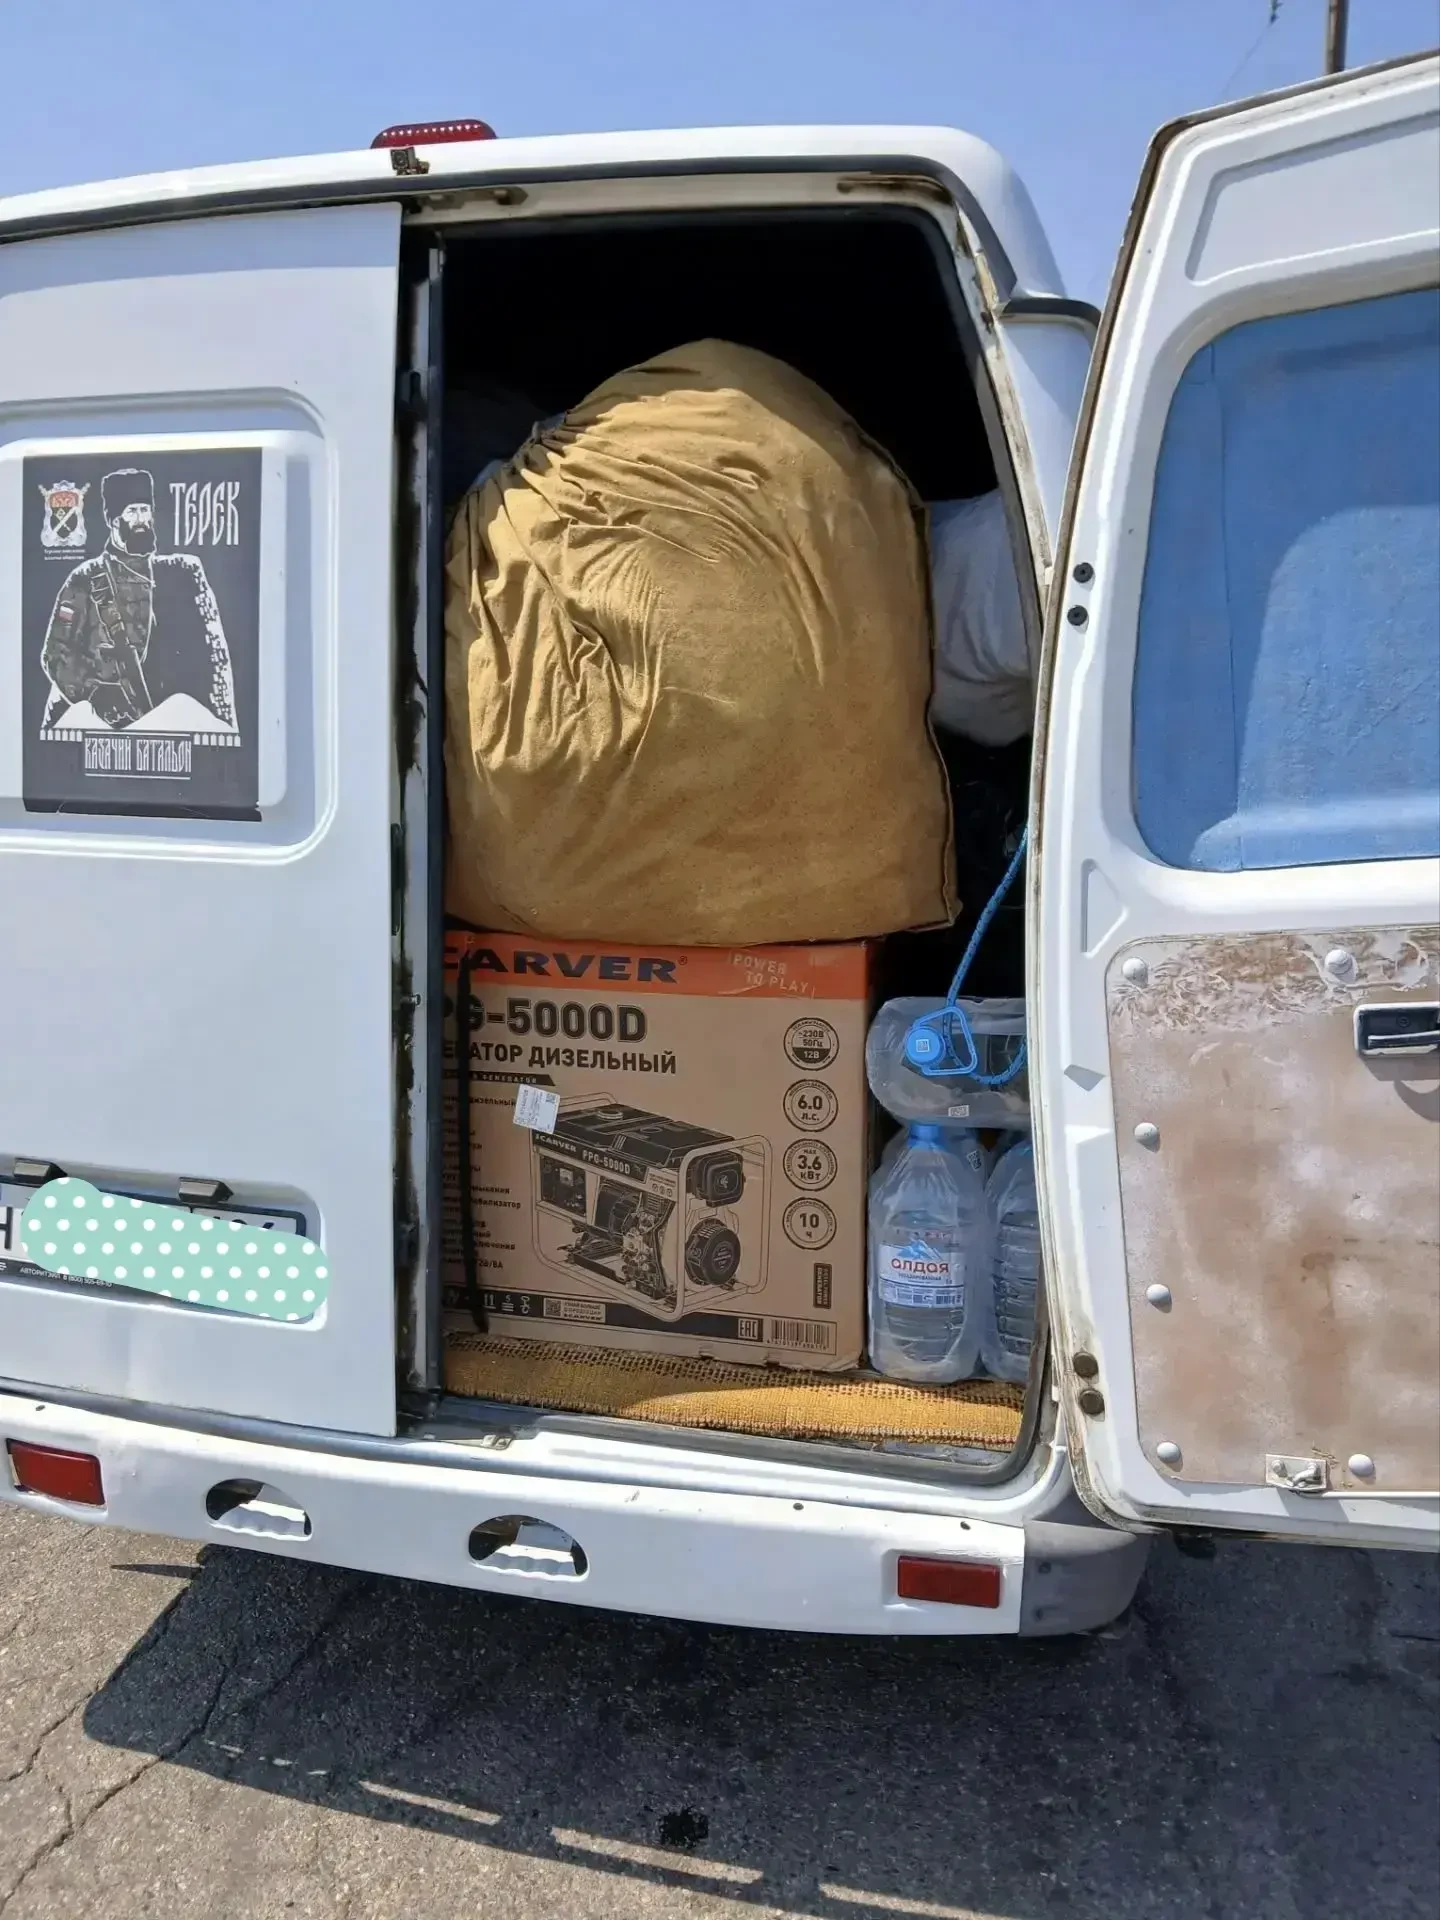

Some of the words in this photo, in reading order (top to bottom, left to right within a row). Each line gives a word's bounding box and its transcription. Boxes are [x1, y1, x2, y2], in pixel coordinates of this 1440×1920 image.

[169, 481, 240, 546] ТЕРЕК
[84, 736, 131, 771] КАЗАЧИЙ
[136, 739, 192, 773] БАТАЛЬОН
[733, 953, 787, 975] POWER
[744, 971, 764, 985] TO
[769, 975, 808, 993] PLAY
[528, 1046, 677, 1075] ДИЗЕЛЬНЫЙ
[803, 1050, 820, 1059] 12В
[797, 1094, 823, 1110] 6.0
[801, 1112, 820, 1121] л.с.
[540, 1135, 577, 1153] CARVER
[797, 1154, 822, 1171] 3.6
[799, 1213, 820, 1228] 10
